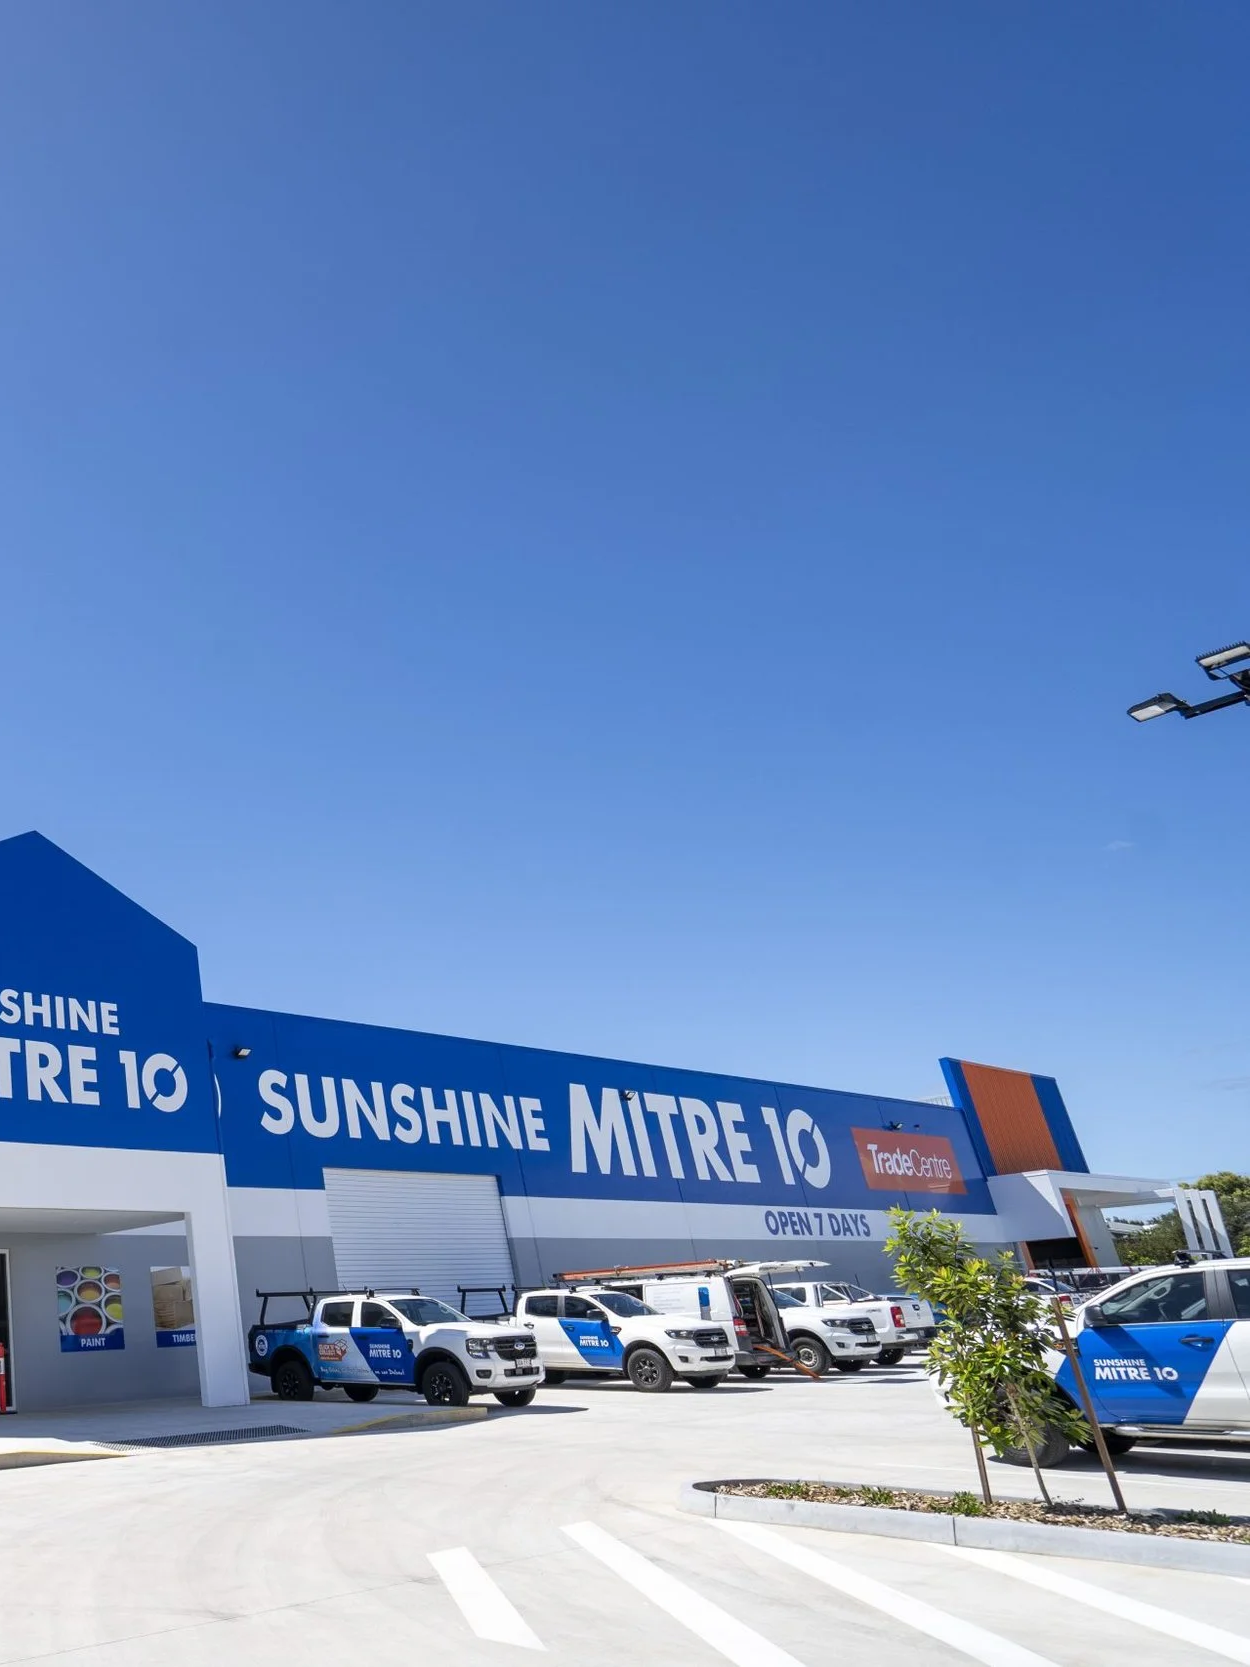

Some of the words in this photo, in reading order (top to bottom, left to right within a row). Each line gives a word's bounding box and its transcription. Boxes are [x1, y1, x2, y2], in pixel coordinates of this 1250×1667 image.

[119, 1050, 188, 1113] 10
[258, 1069, 550, 1151] SUNSHINE
[569, 1083, 762, 1184] MITRE
[762, 1106, 831, 1189] 10
[764, 1210, 813, 1236] OPEN
[814, 1212, 825, 1236] 7
[828, 1212, 871, 1238] DAYS
[81, 1337, 106, 1348] PAINT
[172, 1334, 196, 1343] TIMBE
[600, 1340, 609, 1348] 10
[369, 1349, 391, 1358] MITRE
[392, 1349, 402, 1359] 10
[1093, 1358, 1147, 1367] SUNSHINE
[1095, 1366, 1152, 1380] MITRE
[1153, 1366, 1179, 1381] 10
